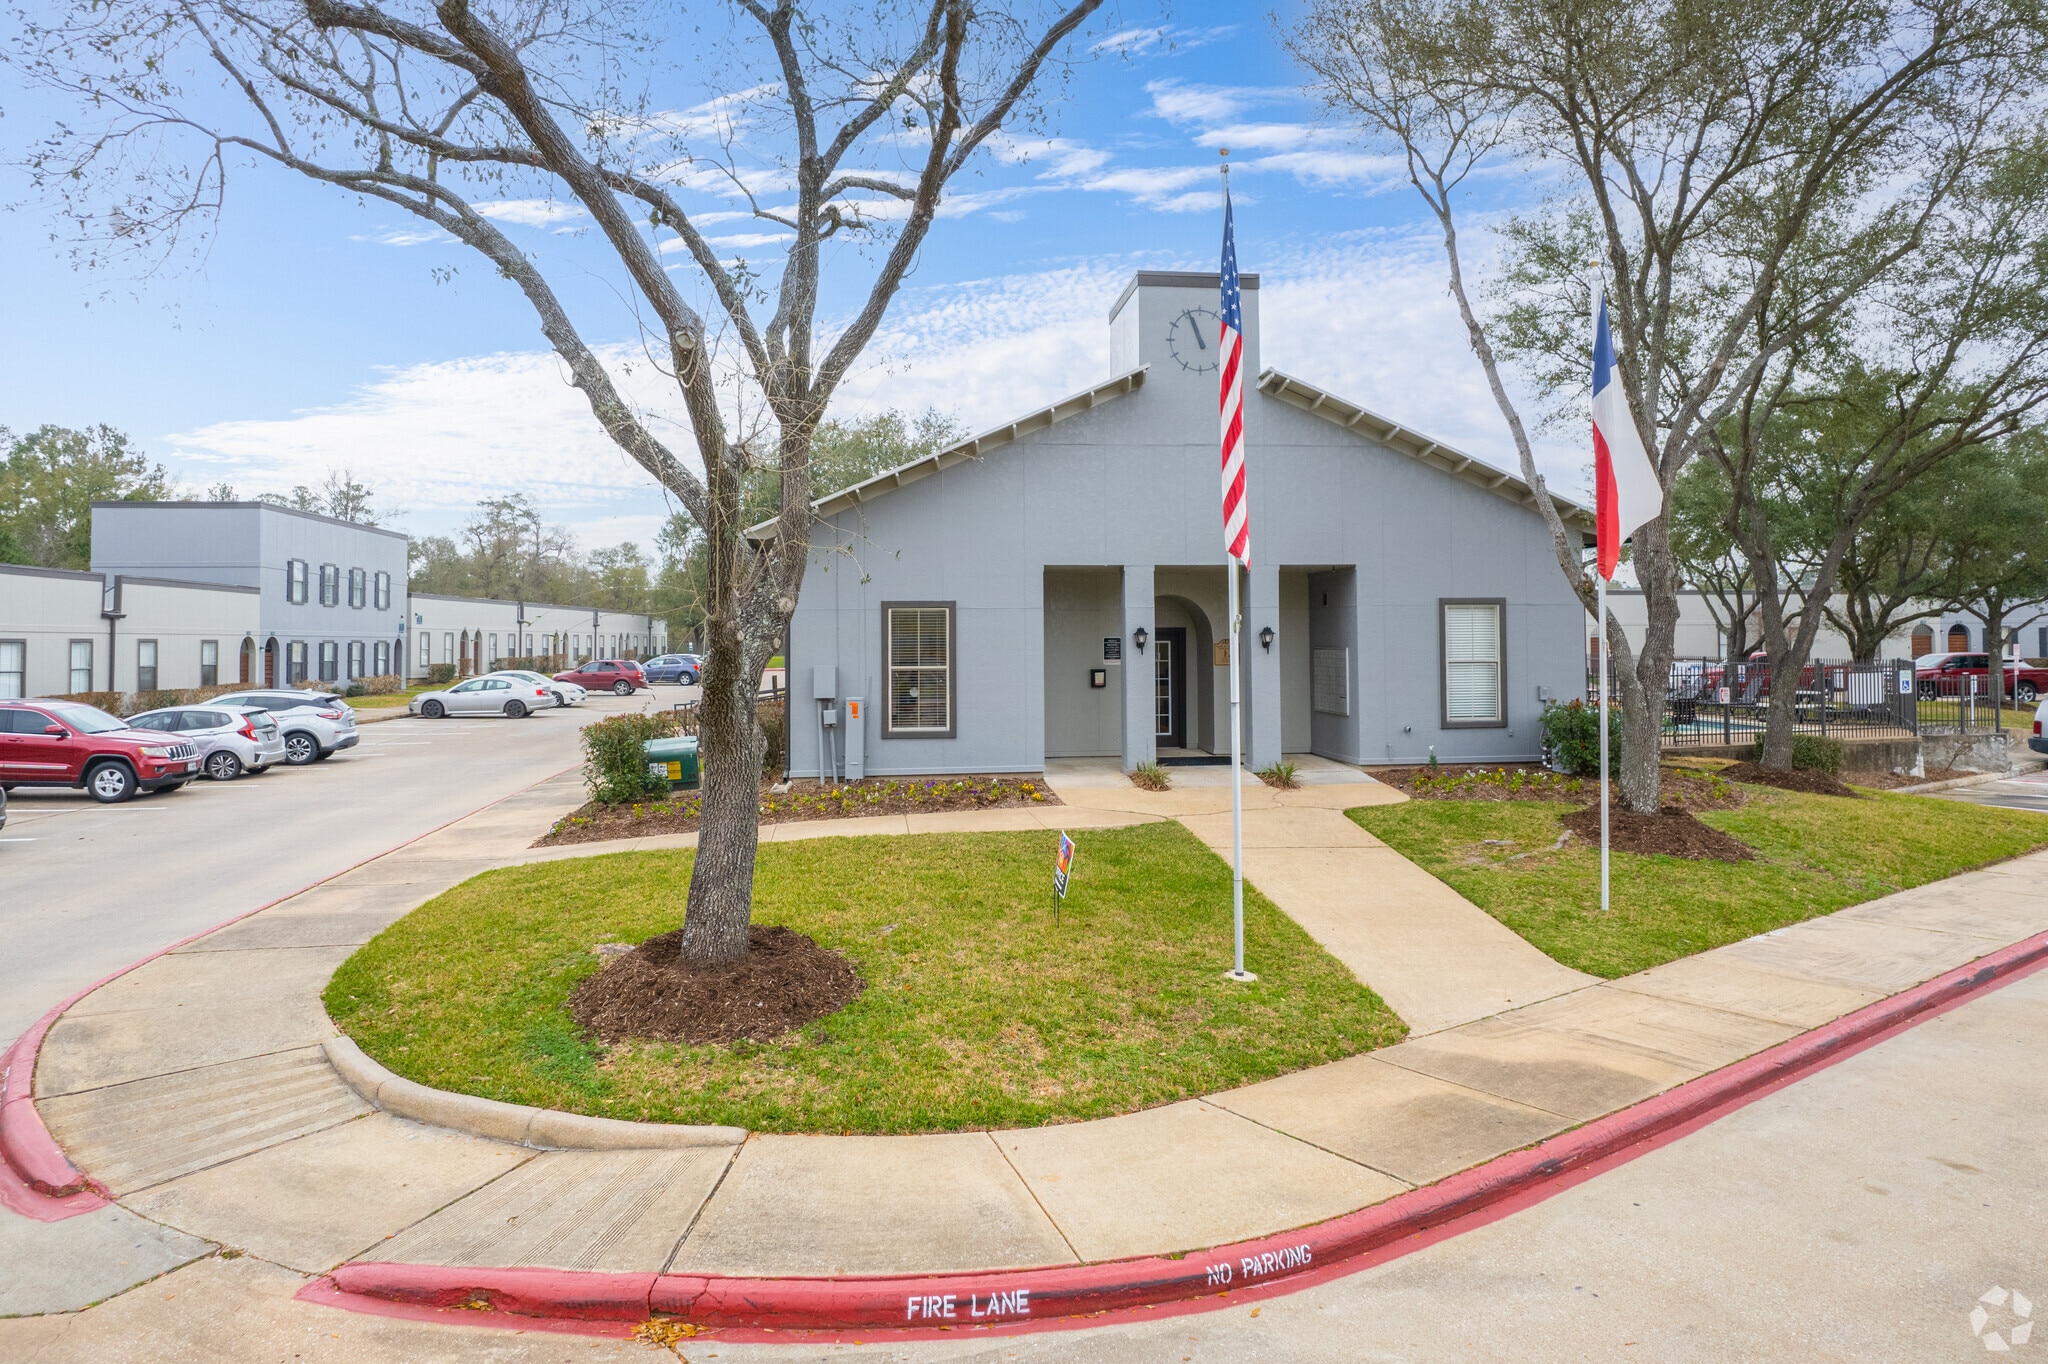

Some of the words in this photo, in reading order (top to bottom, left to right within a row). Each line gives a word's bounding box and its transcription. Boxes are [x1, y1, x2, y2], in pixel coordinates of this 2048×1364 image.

[1206, 1262, 1232, 1286] NO
[1241, 1244, 1312, 1279] PARKING
[907, 1295, 957, 1320] FIRE
[971, 1290, 1030, 1317] LANE
